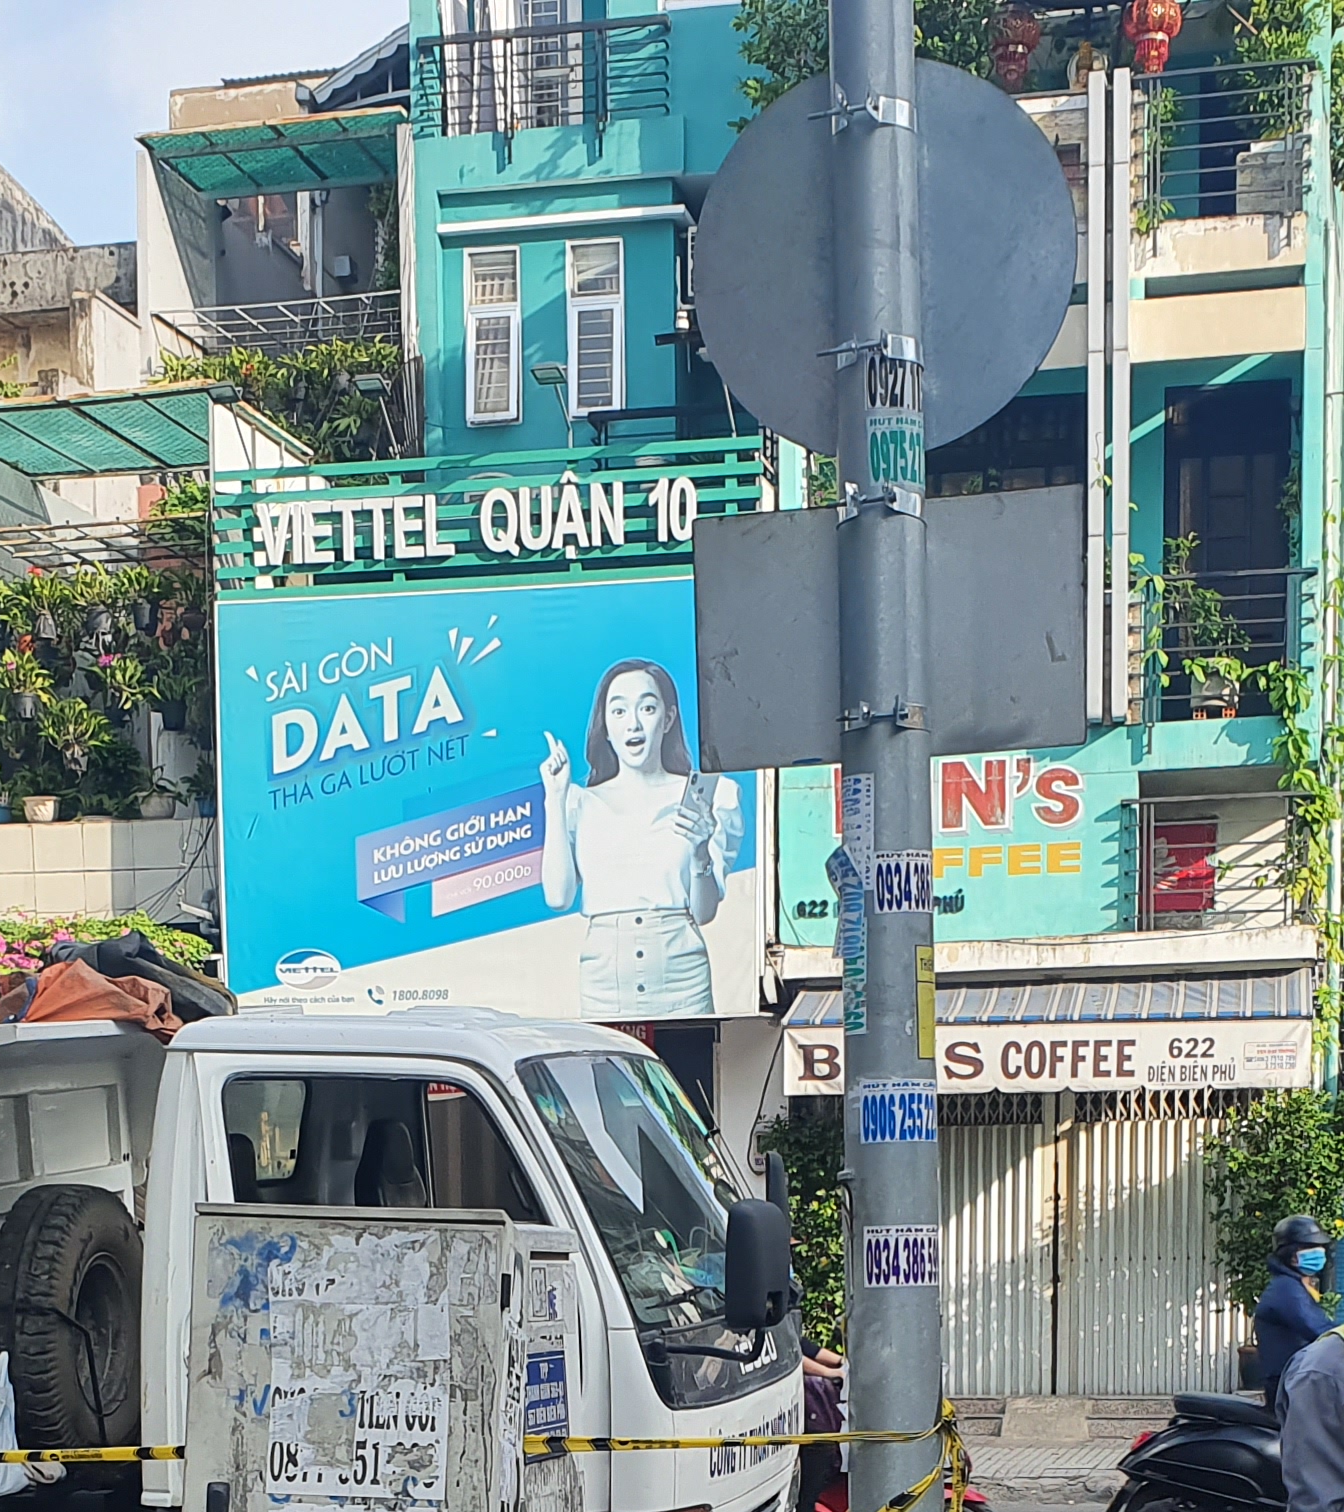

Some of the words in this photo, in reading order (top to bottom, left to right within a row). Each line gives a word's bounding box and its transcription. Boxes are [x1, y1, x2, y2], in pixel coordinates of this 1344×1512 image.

[257, 495, 455, 566] VIETTEL
[479, 471, 625, 560] QUẬN
[649, 476, 698, 542] 10
[265, 661, 308, 702] SÀI
[317, 636, 393, 685] GÒN
[271, 666, 464, 775] DATA
[320, 770, 352, 795] GA
[373, 831, 442, 864] KHÔNG
[445, 815, 486, 842] GIỚI
[489, 802, 532, 828] HẠN
[373, 863, 404, 885] LƯU
[406, 848, 461, 875] LƯỢNG
[463, 836, 486, 858] SỬ
[486, 824, 532, 850] DỤNG
[932, 842, 1082, 879] FFEE
[392, 989, 449, 1001] 1800.8098
[1000, 1039, 1137, 1080] COFFEE
[1168, 1037, 1215, 1059] 622
[1147, 1060, 1175, 1086] ĐIỆN
[1179, 1060, 1207, 1083] BIÊN
[1212, 1057, 1236, 1083] PHỦ
